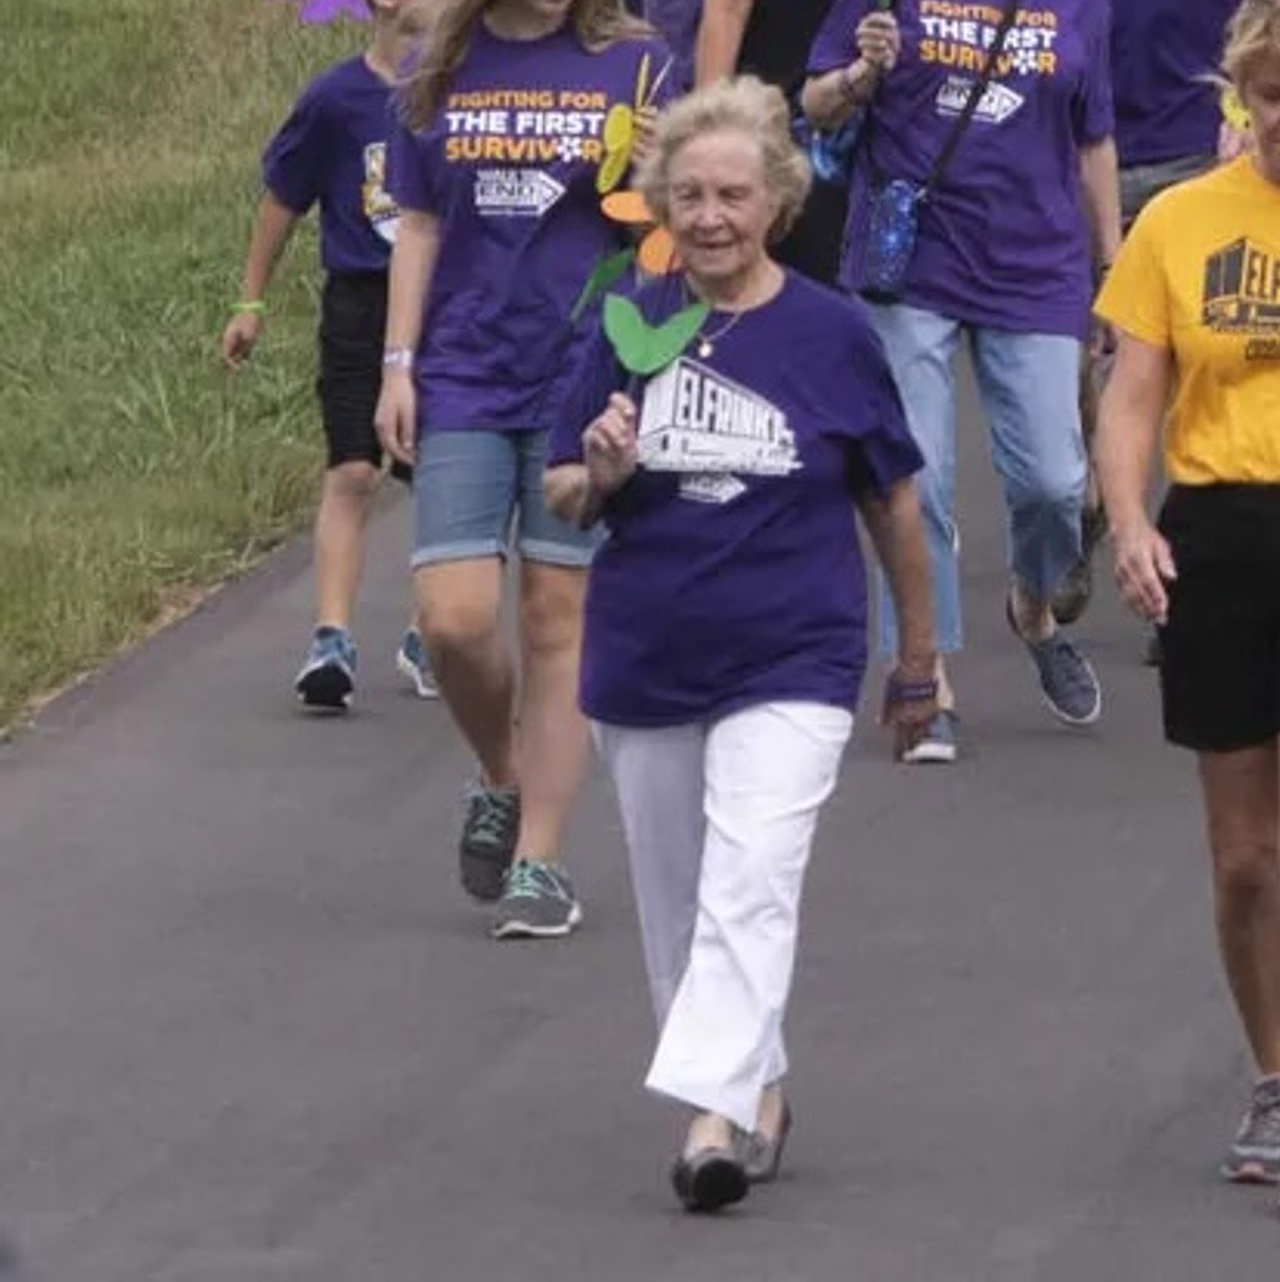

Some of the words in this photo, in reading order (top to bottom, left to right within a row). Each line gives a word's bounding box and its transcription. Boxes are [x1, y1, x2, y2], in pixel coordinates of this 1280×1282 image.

[919, 17, 978, 43] THE
[448, 90, 556, 109] FIGHTING
[561, 91, 607, 109] FOR
[445, 110, 510, 133] THE
[516, 111, 605, 135] FIRST
